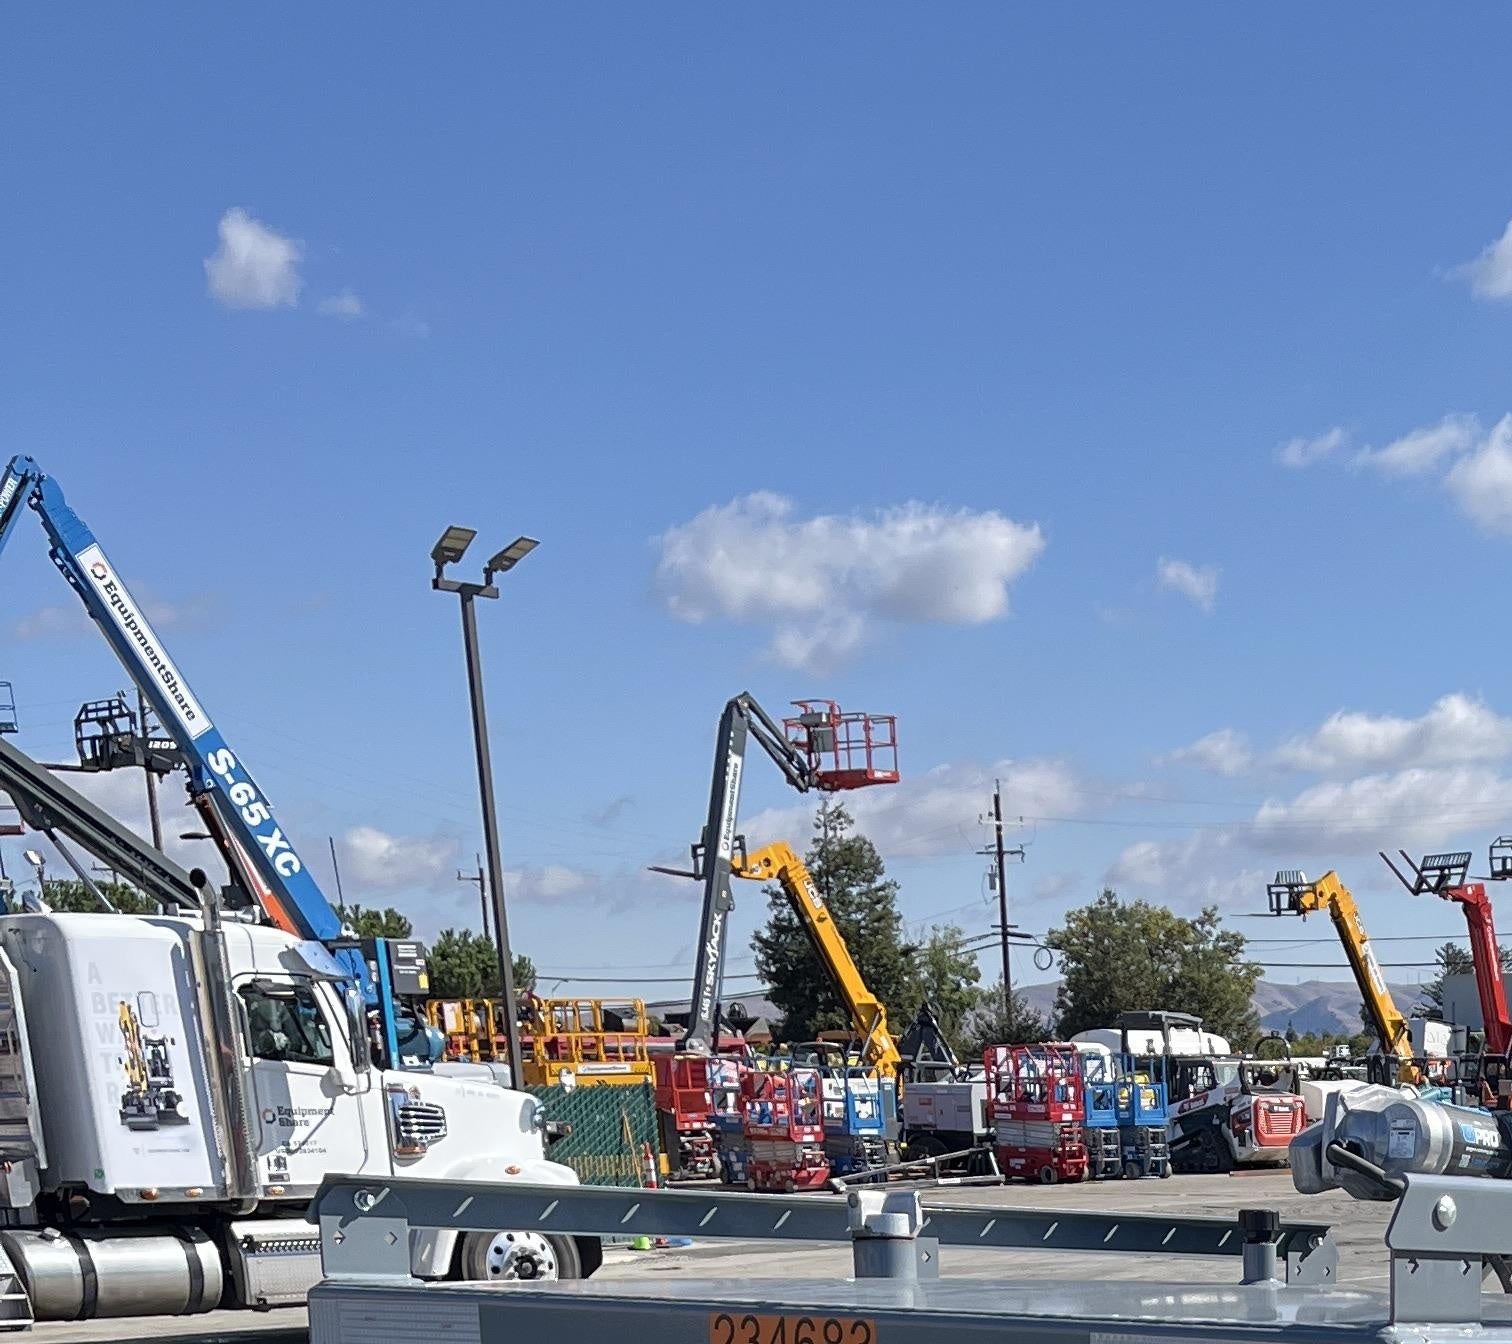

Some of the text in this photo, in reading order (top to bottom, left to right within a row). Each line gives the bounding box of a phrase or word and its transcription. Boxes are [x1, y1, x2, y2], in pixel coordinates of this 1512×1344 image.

[103, 579, 195, 721] EquipmentShare
[208, 748, 300, 877] S-65 XC
[804, 880, 823, 909] JCB
[706, 911, 722, 986] SKYJACK
